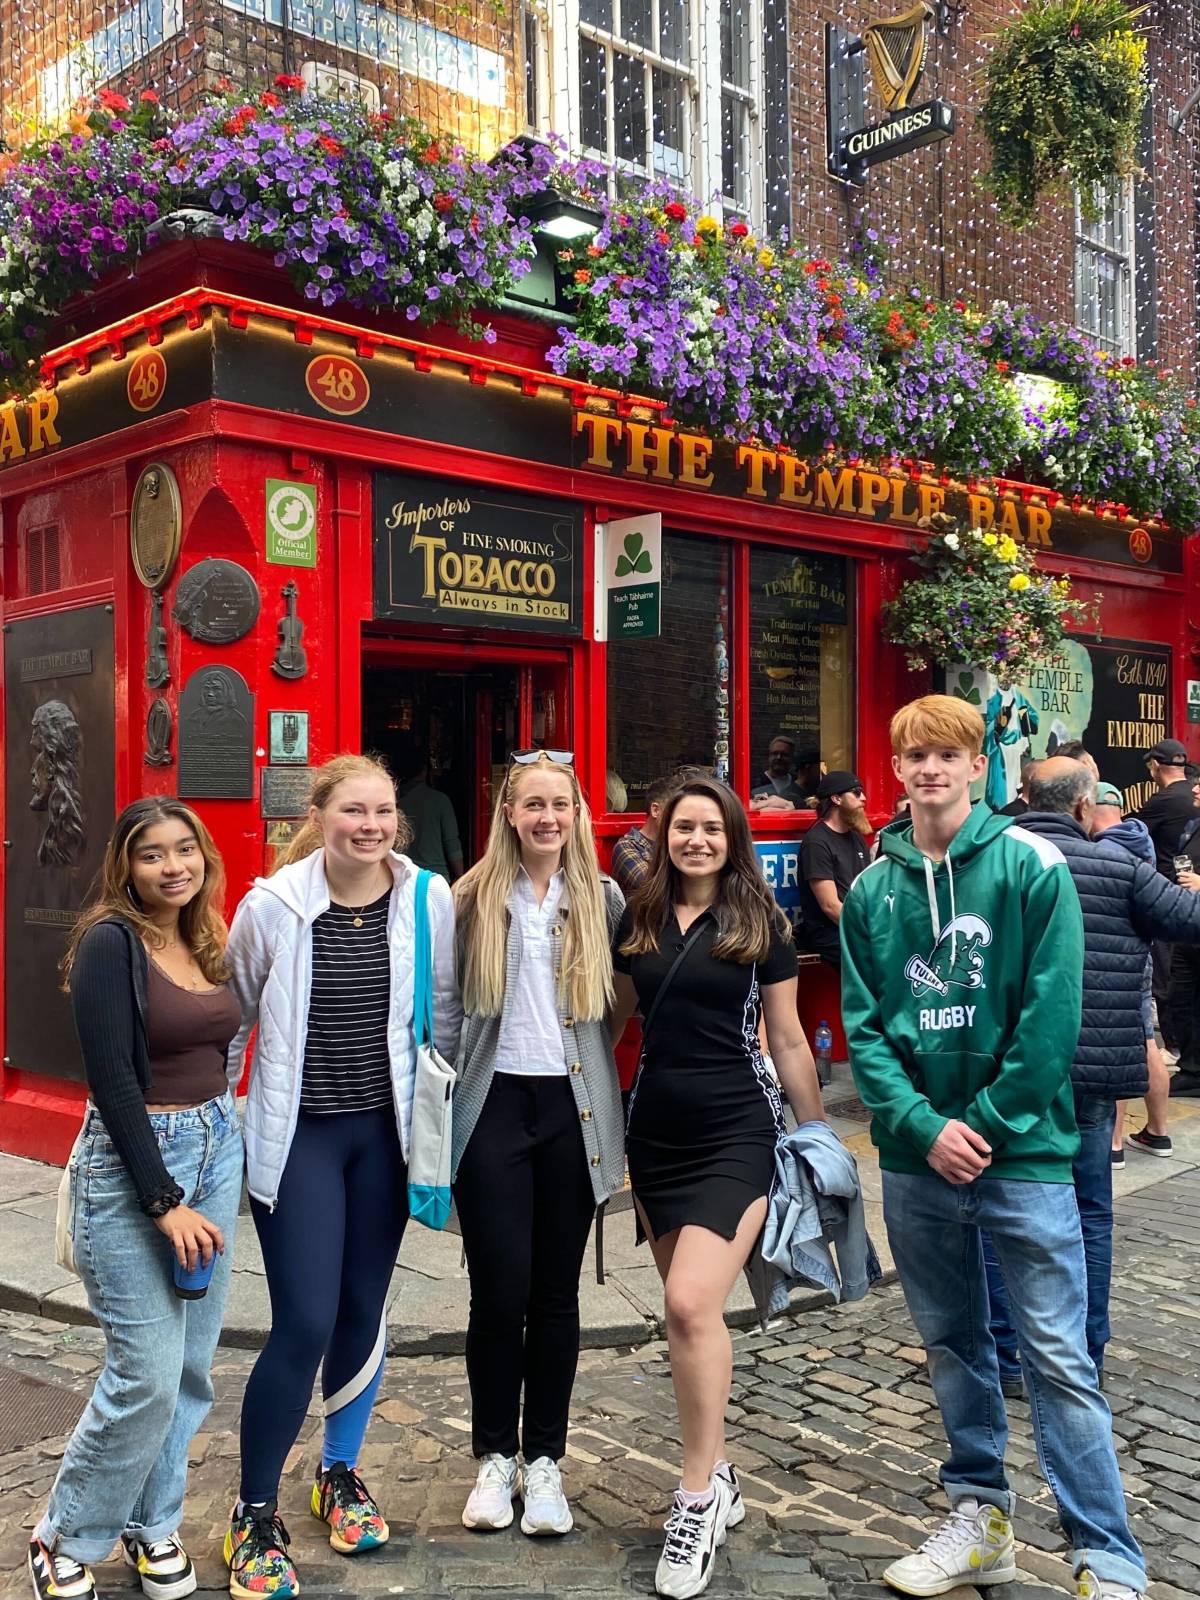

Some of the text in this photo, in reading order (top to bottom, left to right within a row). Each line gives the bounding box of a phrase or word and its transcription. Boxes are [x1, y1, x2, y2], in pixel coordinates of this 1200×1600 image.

[848, 108, 931, 155] GUINNESS
[134, 364, 158, 401] 48
[317, 362, 356, 400] 48
[576, 411, 1053, 546] THE TEMPLE BAR
[385, 497, 471, 533] Importers
[440, 520, 455, 532] OF
[275, 547, 309, 558] Member
[277, 538, 306, 549] Official
[462, 532, 555, 557] FINE SMOKING
[1132, 535, 1148, 555] 48
[409, 533, 556, 599] TOBACCO
[441, 590, 567, 617] Always in Stock
[628, 601, 639, 611] Pub
[769, 618, 806, 631] Traditional
[761, 631, 781, 644] Meat
[1028, 668, 1084, 693] TEMPLE
[1145, 661, 1167, 688] 1840
[1040, 690, 1071, 715] BAR
[1138, 693, 1165, 721] THE
[914, 962, 940, 988] TULANE
[919, 1005, 976, 1030] RUGBY
[766, 1087, 781, 1116] PUMA
